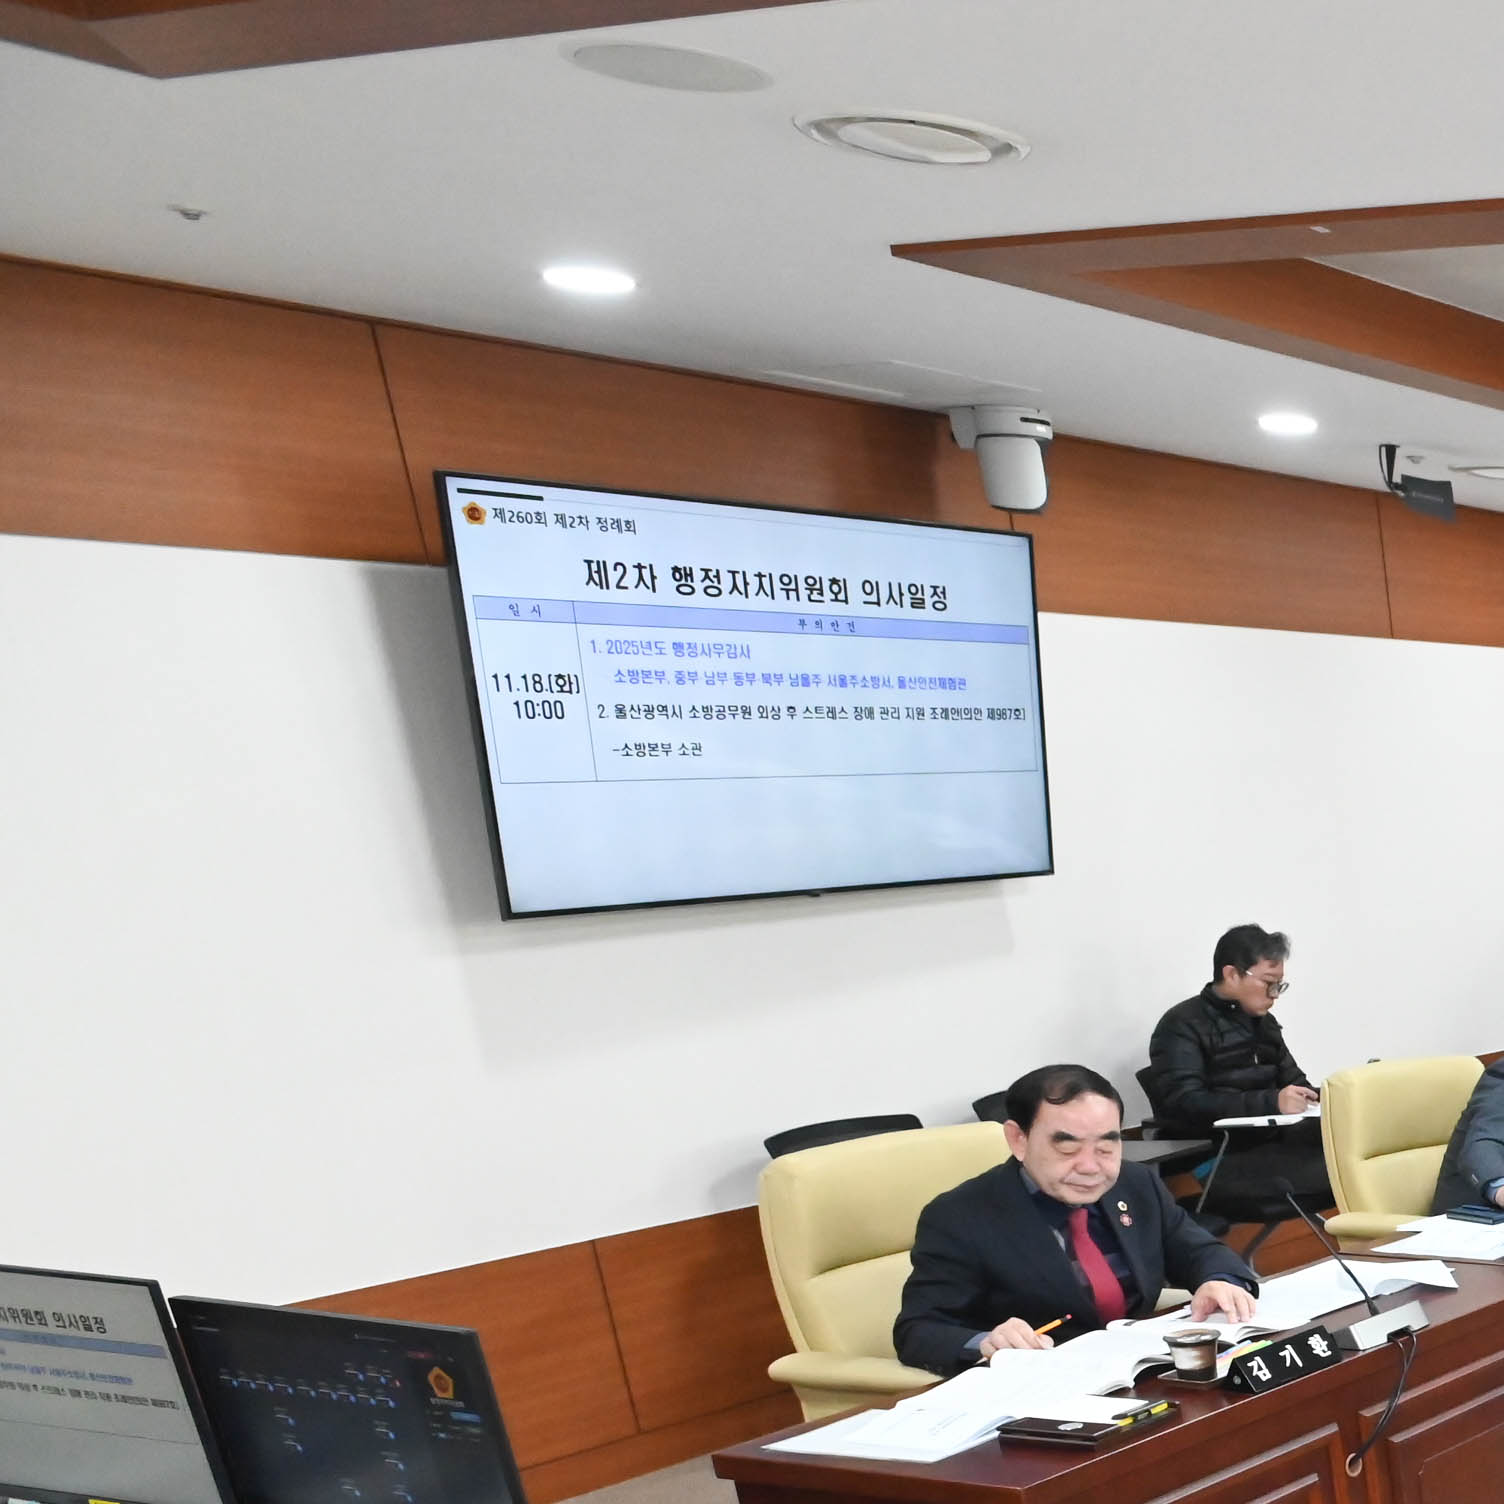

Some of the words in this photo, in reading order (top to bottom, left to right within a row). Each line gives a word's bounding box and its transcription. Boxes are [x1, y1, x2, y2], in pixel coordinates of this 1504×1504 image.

[491, 507, 548, 527] 제260회
[554, 513, 590, 531] 제2차
[595, 517, 637, 535] 정례회
[582, 558, 658, 593] 제2차
[670, 564, 849, 606] 행정자치위원회
[861, 579, 948, 612] 의사일정
[606, 639, 667, 656] 2025년도
[672, 641, 751, 659] 행정사무감사
[512, 699, 565, 720] 10:00
[614, 704, 683, 720] 울산광역시
[688, 704, 752, 720] 소방공무원
[757, 705, 781, 721] 외상
[786, 706, 797, 720] 후
[802, 705, 849, 720] 스트레스
[853, 706, 875, 721] 장애
[879, 706, 901, 721] 관리
[905, 706, 926, 721] 지원
[678, 742, 703, 758] 소관
[52, 1311, 107, 1334] 의사일정
[1246, 1333, 1332, 1382] 김기환
